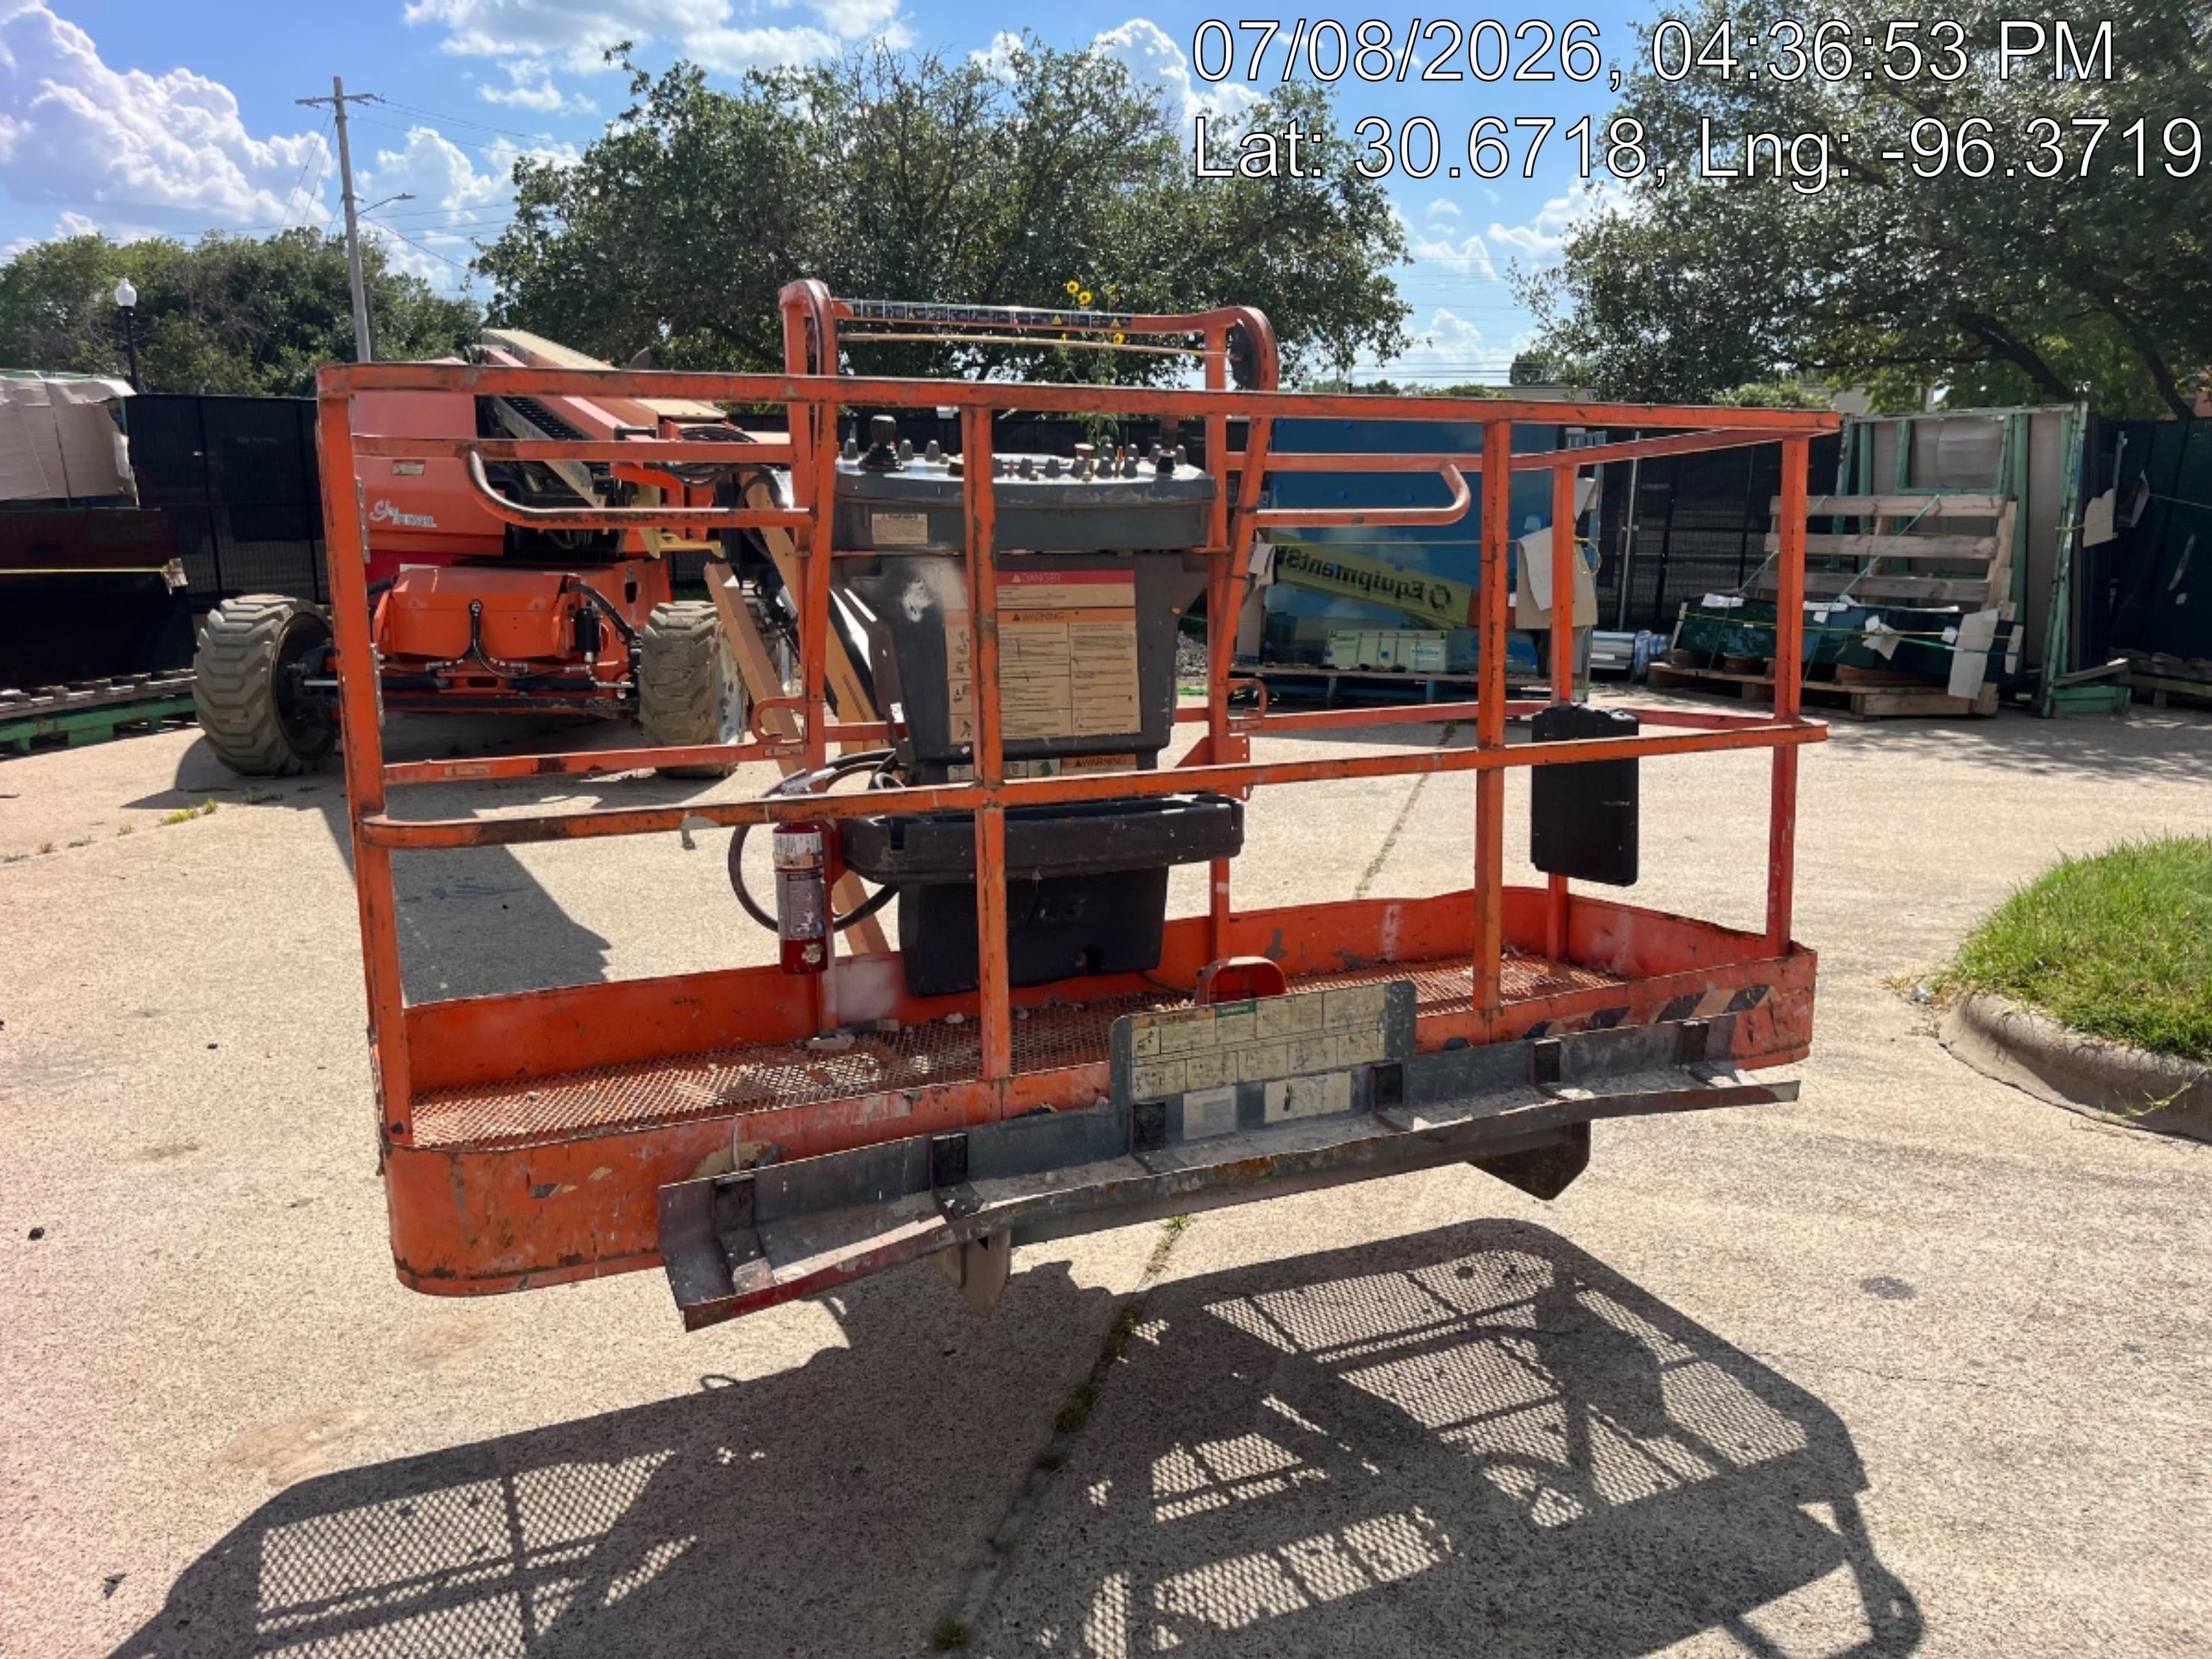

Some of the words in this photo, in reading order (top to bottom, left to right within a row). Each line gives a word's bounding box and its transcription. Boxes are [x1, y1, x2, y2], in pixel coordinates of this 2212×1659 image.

[1022, 573, 1061, 583] DANGER
[1022, 611, 1065, 621] WARNING
[1081, 756, 1127, 767] WARNING
